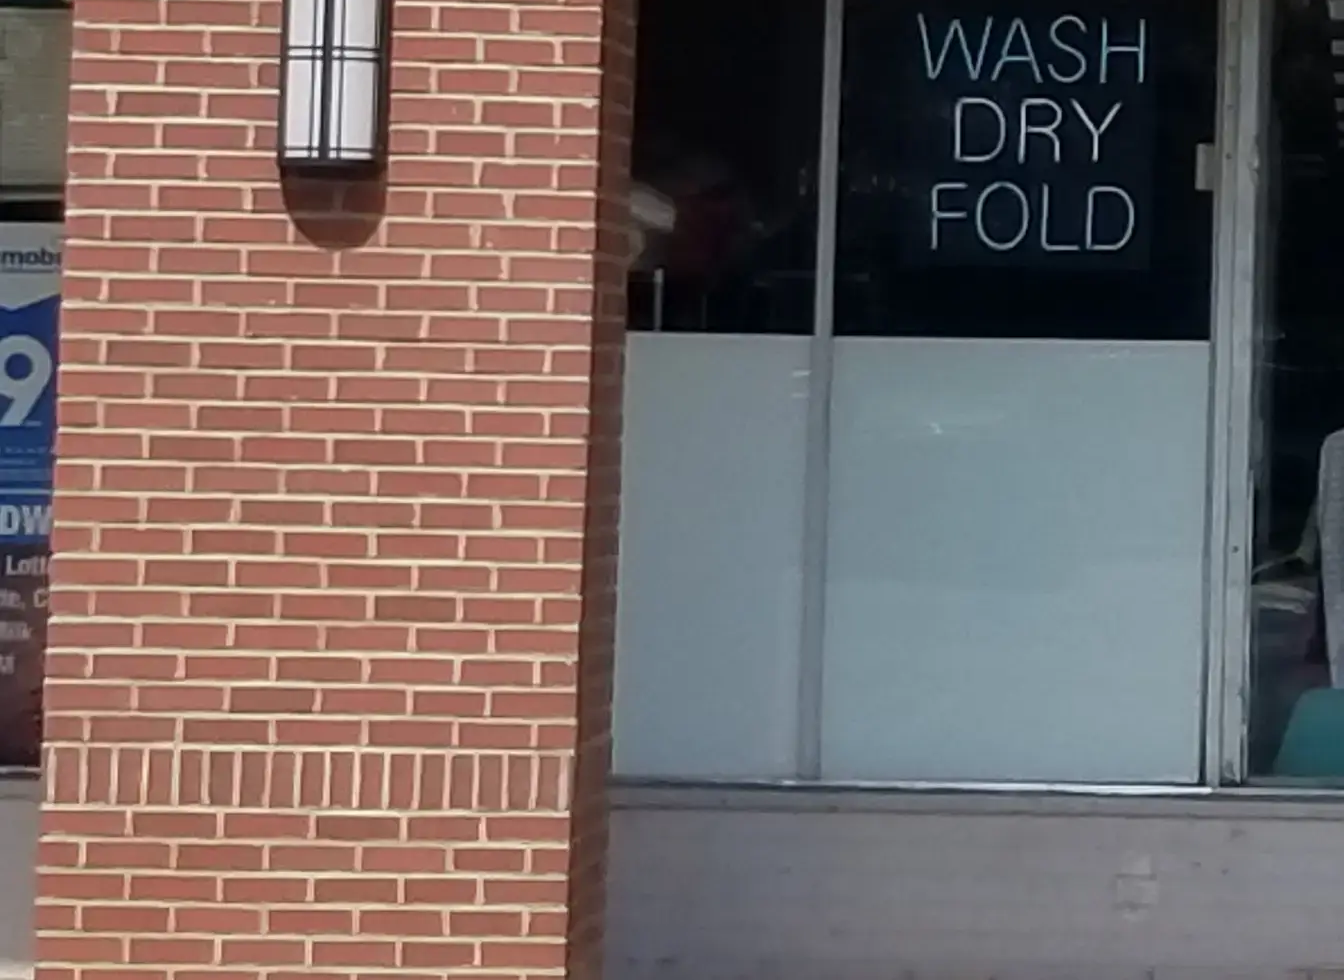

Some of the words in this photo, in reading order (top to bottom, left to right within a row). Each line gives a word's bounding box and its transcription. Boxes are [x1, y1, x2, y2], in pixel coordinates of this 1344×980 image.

[917, 12, 1146, 84] WASH
[953, 96, 1123, 165] DRY
[930, 181, 1136, 252] FOLD
